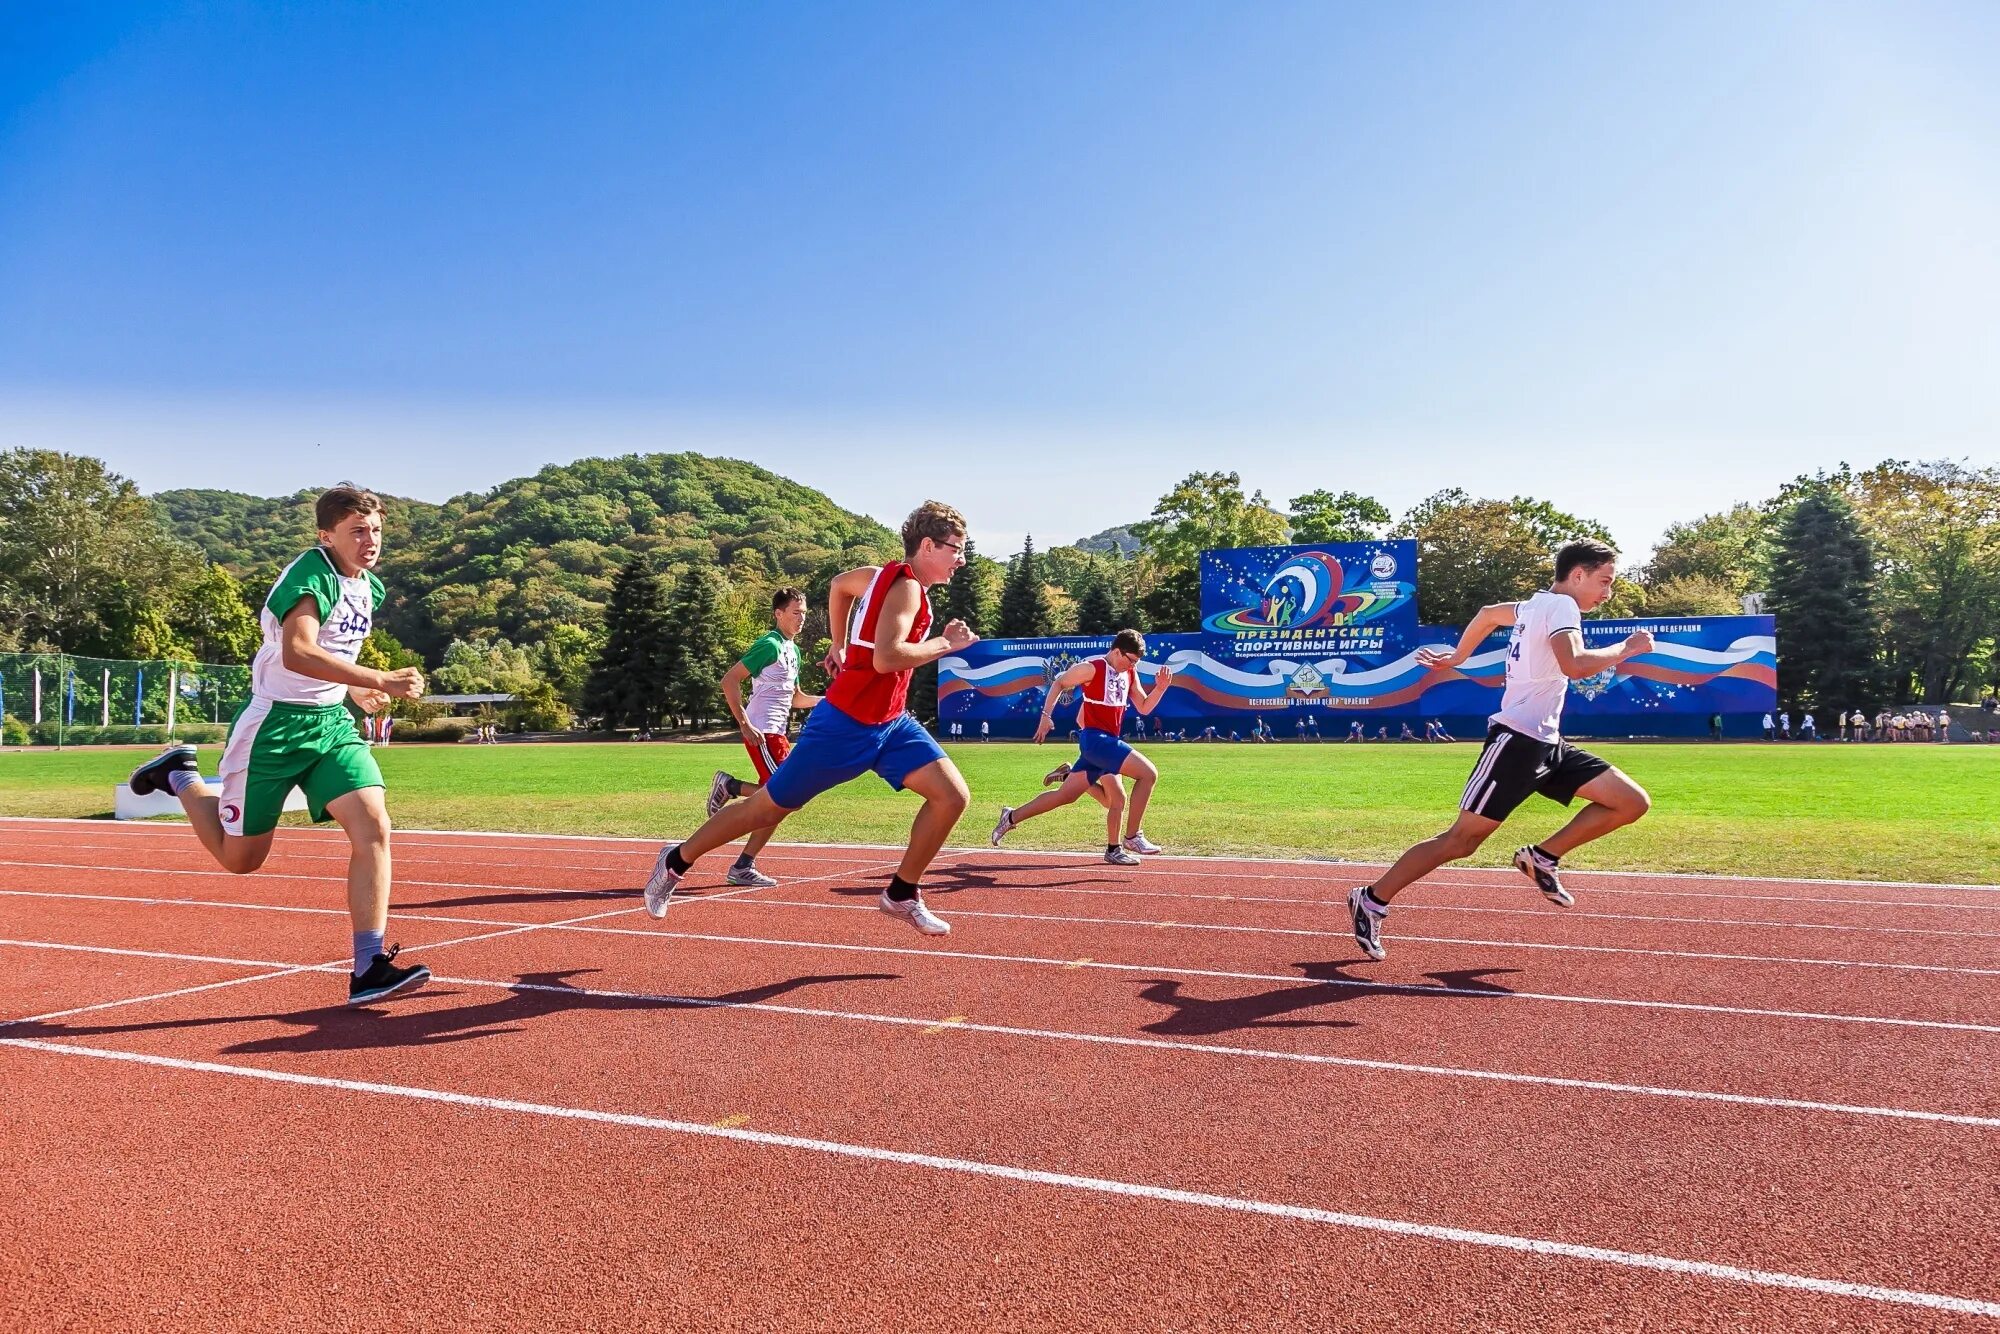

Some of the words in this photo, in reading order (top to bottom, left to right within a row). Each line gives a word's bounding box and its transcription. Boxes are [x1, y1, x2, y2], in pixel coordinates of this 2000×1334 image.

[1236, 627, 1385, 640] ПРЕЗИДЕНТСКИЕ
[1591, 626, 1613, 635] НАУКИ
[1659, 624, 1702, 634] ФЕДЕРАЦИИ
[1002, 643, 1042, 651] МИНИСТЕРСТВО
[1043, 642, 1063, 650] СПОРТА
[1063, 641, 1097, 649] РОССИЙСКОЙ
[1234, 640, 1336, 652] СПОРТИВНЫЕ
[1339, 639, 1384, 649] ИГРЫ
[1249, 697, 1295, 706] ВСЕРОССИЙСКИЙ
[1295, 697, 1321, 706] ДЕТСКИЙ
[1321, 697, 1340, 706] ЦЕНТР
